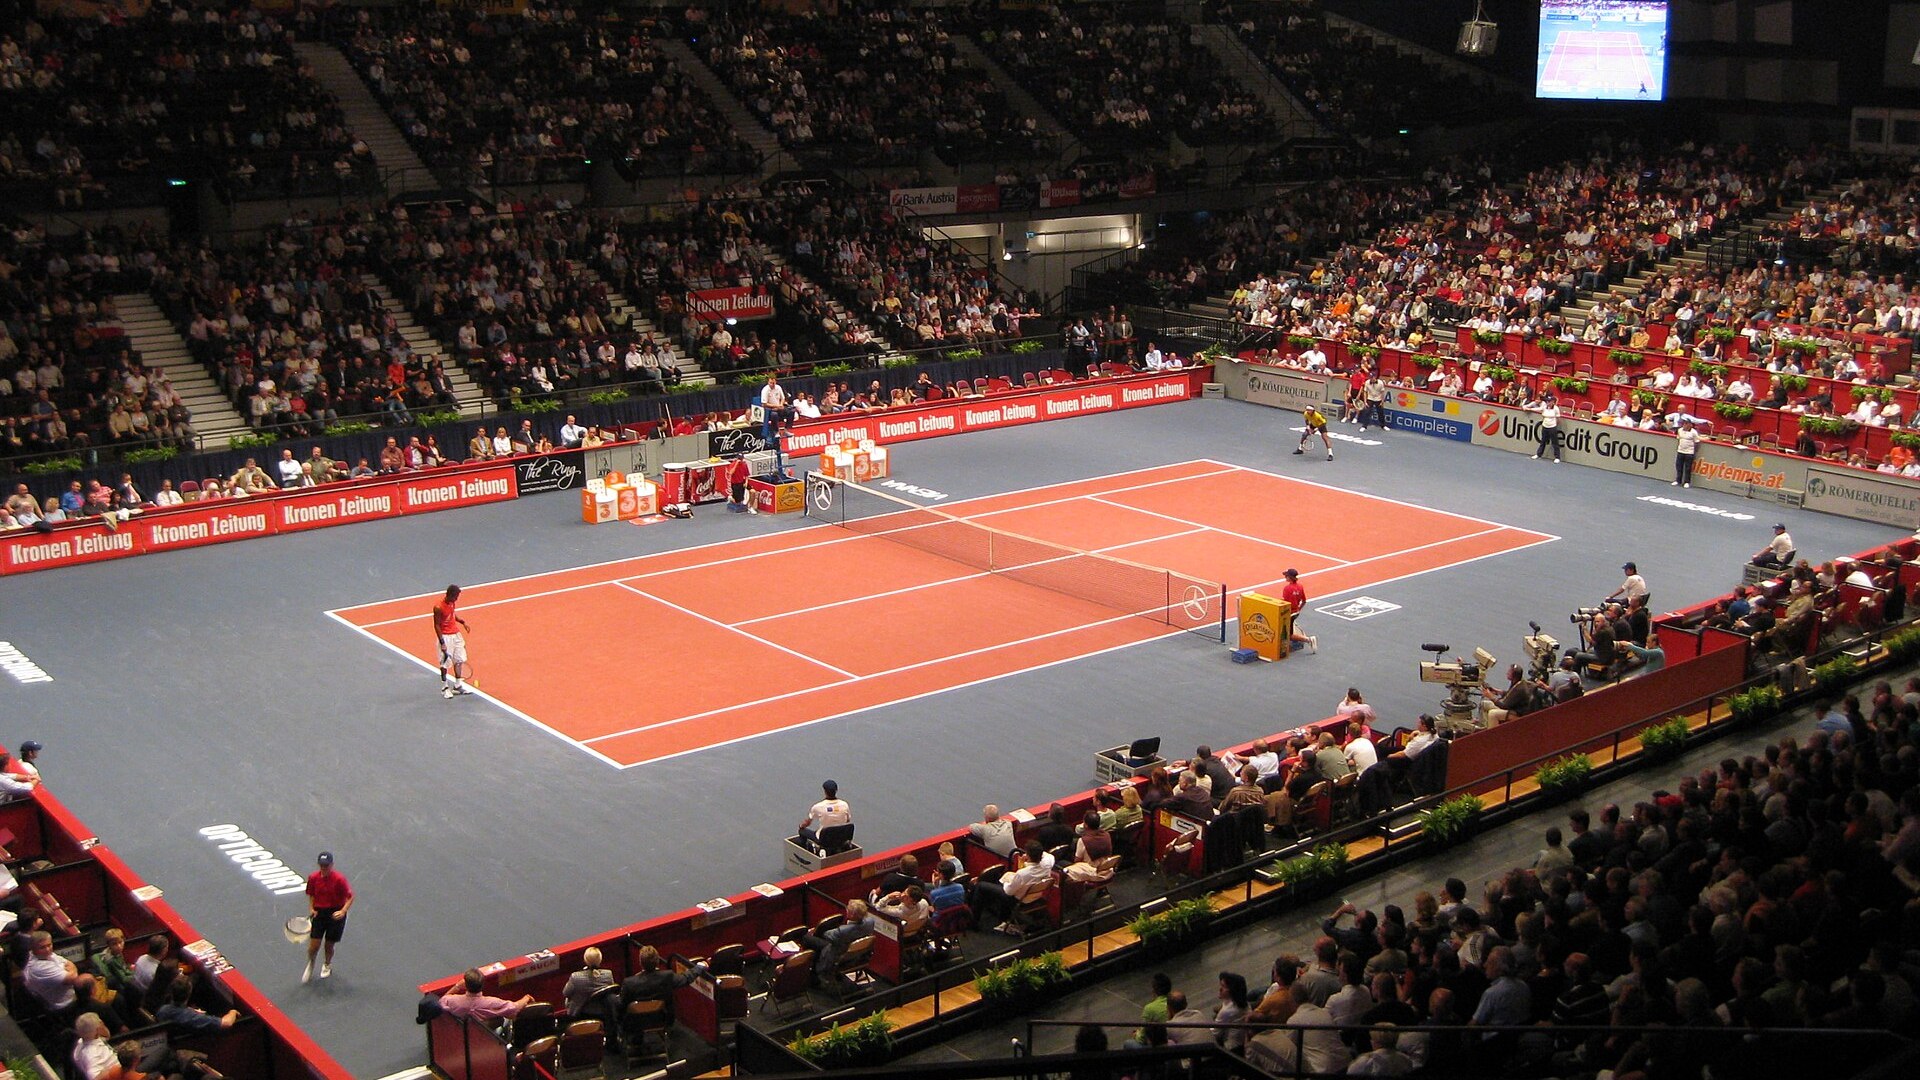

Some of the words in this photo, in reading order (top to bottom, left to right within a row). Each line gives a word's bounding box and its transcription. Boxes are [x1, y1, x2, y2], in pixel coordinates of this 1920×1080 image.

[902, 193, 925, 206] Bank
[927, 191, 955, 204] Austria
[1123, 386, 1153, 402] Kronen
[1155, 382, 1184, 398] Zeitung
[1263, 379, 1319, 399] RÖMERQUELLE
[966, 407, 1000, 425] Kronen
[1002, 403, 1036, 420] Zeitung
[1047, 398, 1079, 414] Kronen
[1081, 393, 1112, 409] Zeitung
[880, 419, 917, 438] Kronen
[919, 414, 955, 433] Zeitung
[1397, 416, 1457, 435] complete
[715, 429, 741, 451] The
[788, 432, 827, 450] Kronen
[829, 426, 867, 444] Zeitung
[1504, 415, 1592, 452] UniCedit
[1595, 431, 1658, 469] Group
[519, 455, 548, 480] The
[550, 459, 581, 489] Ring
[408, 483, 458, 505] Kronen
[460, 477, 507, 499] Zeitung
[1829, 484, 1916, 510] RÖMERQUELLE
[285, 501, 337, 524] Kronen
[339, 494, 390, 517] Zeitung
[153, 520, 208, 544] Kronen
[211, 513, 265, 535] Zeitung
[11, 540, 71, 564] Kronen
[75, 530, 133, 554] Zeitung
[200, 823, 308, 895] OPTICOURT
